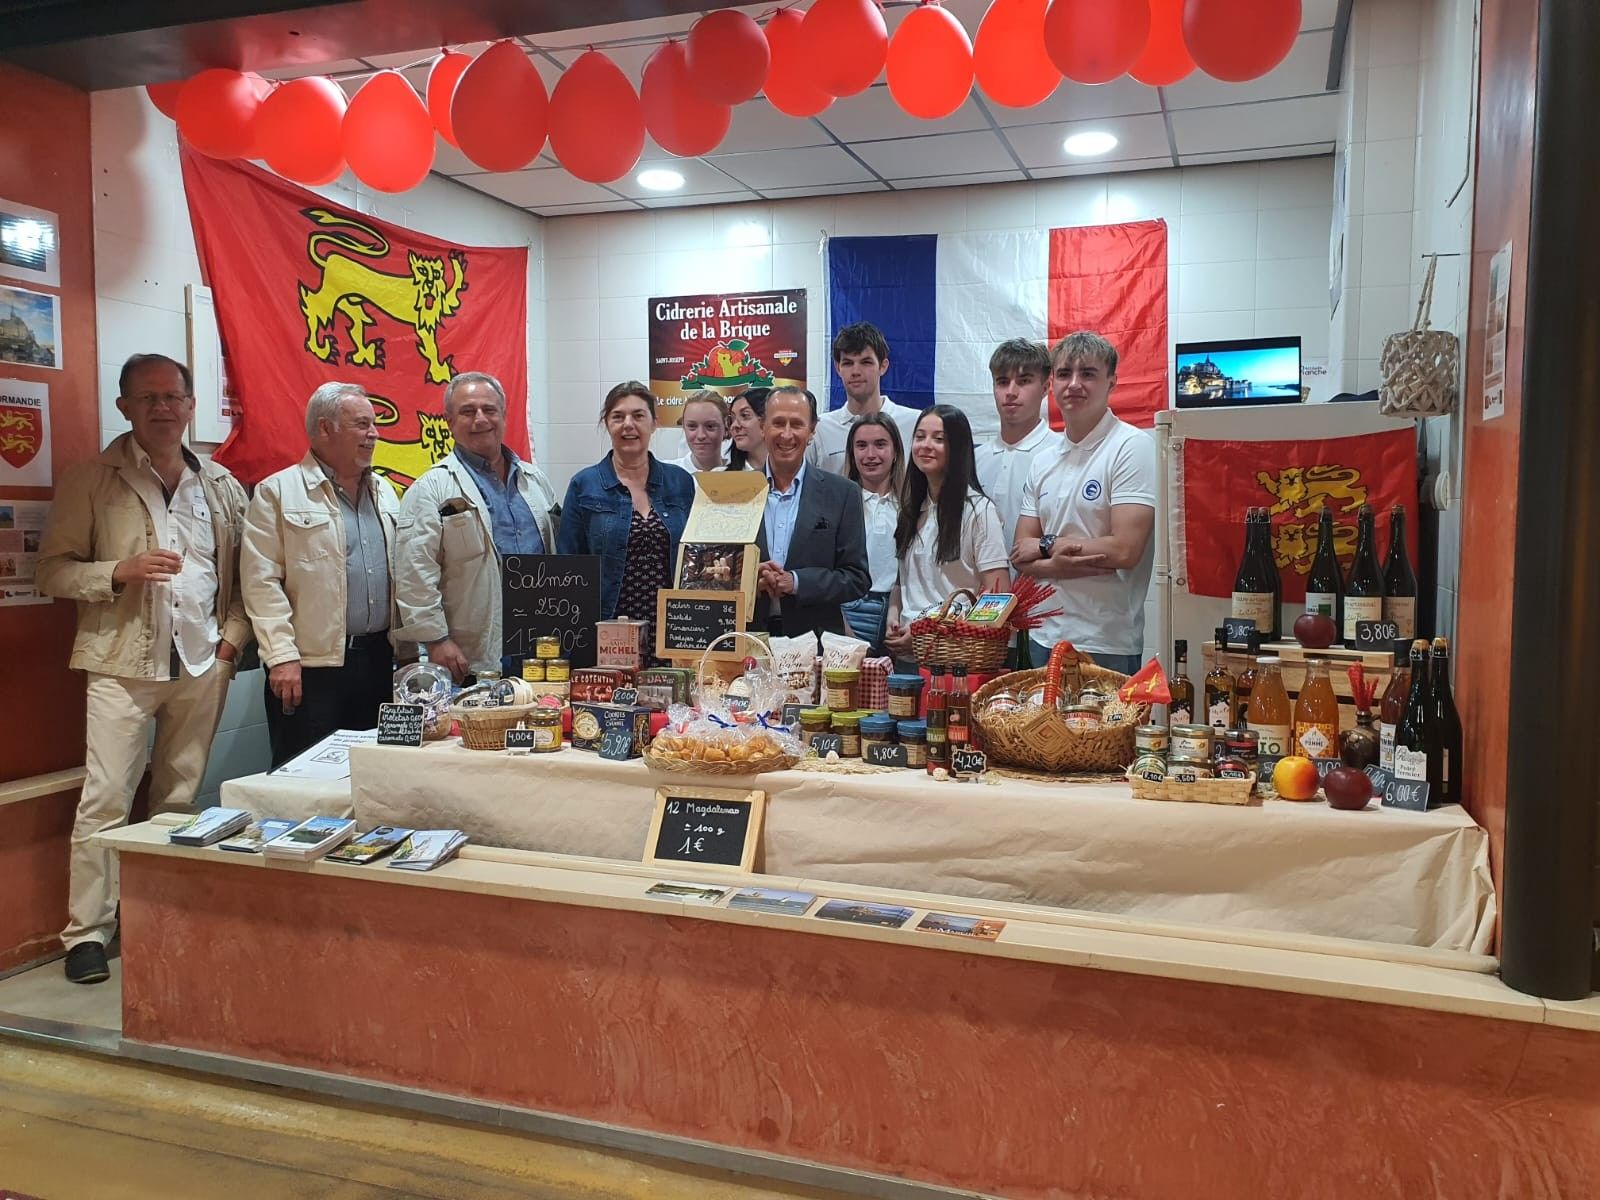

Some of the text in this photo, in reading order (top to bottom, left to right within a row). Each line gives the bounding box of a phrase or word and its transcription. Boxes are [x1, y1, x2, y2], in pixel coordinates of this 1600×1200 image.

[655, 295, 798, 321] Cidrerie Artisanale
[680, 320, 771, 340] de la Brique
[0, 395, 42, 407] RMANDIE
[666, 395, 684, 406] cidre
[506, 556, 589, 590] Salmón
[534, 597, 582, 624] 250g
[1226, 623, 1254, 638] 3,80
[1360, 623, 1396, 643] 3,80€
[600, 646, 637, 655] MICHEL
[571, 675, 579, 684] LE
[580, 674, 614, 684] COTENTIN
[508, 731, 533, 743] 4,00€
[811, 736, 838, 751] 5,10€
[873, 747, 899, 761] 4,80€
[1259, 742, 1281, 755] IO
[955, 752, 984, 769] 4,20€
[1385, 781, 1421, 805] 6,00€
[667, 801, 680, 814] 12
[693, 824, 714, 832] 100
